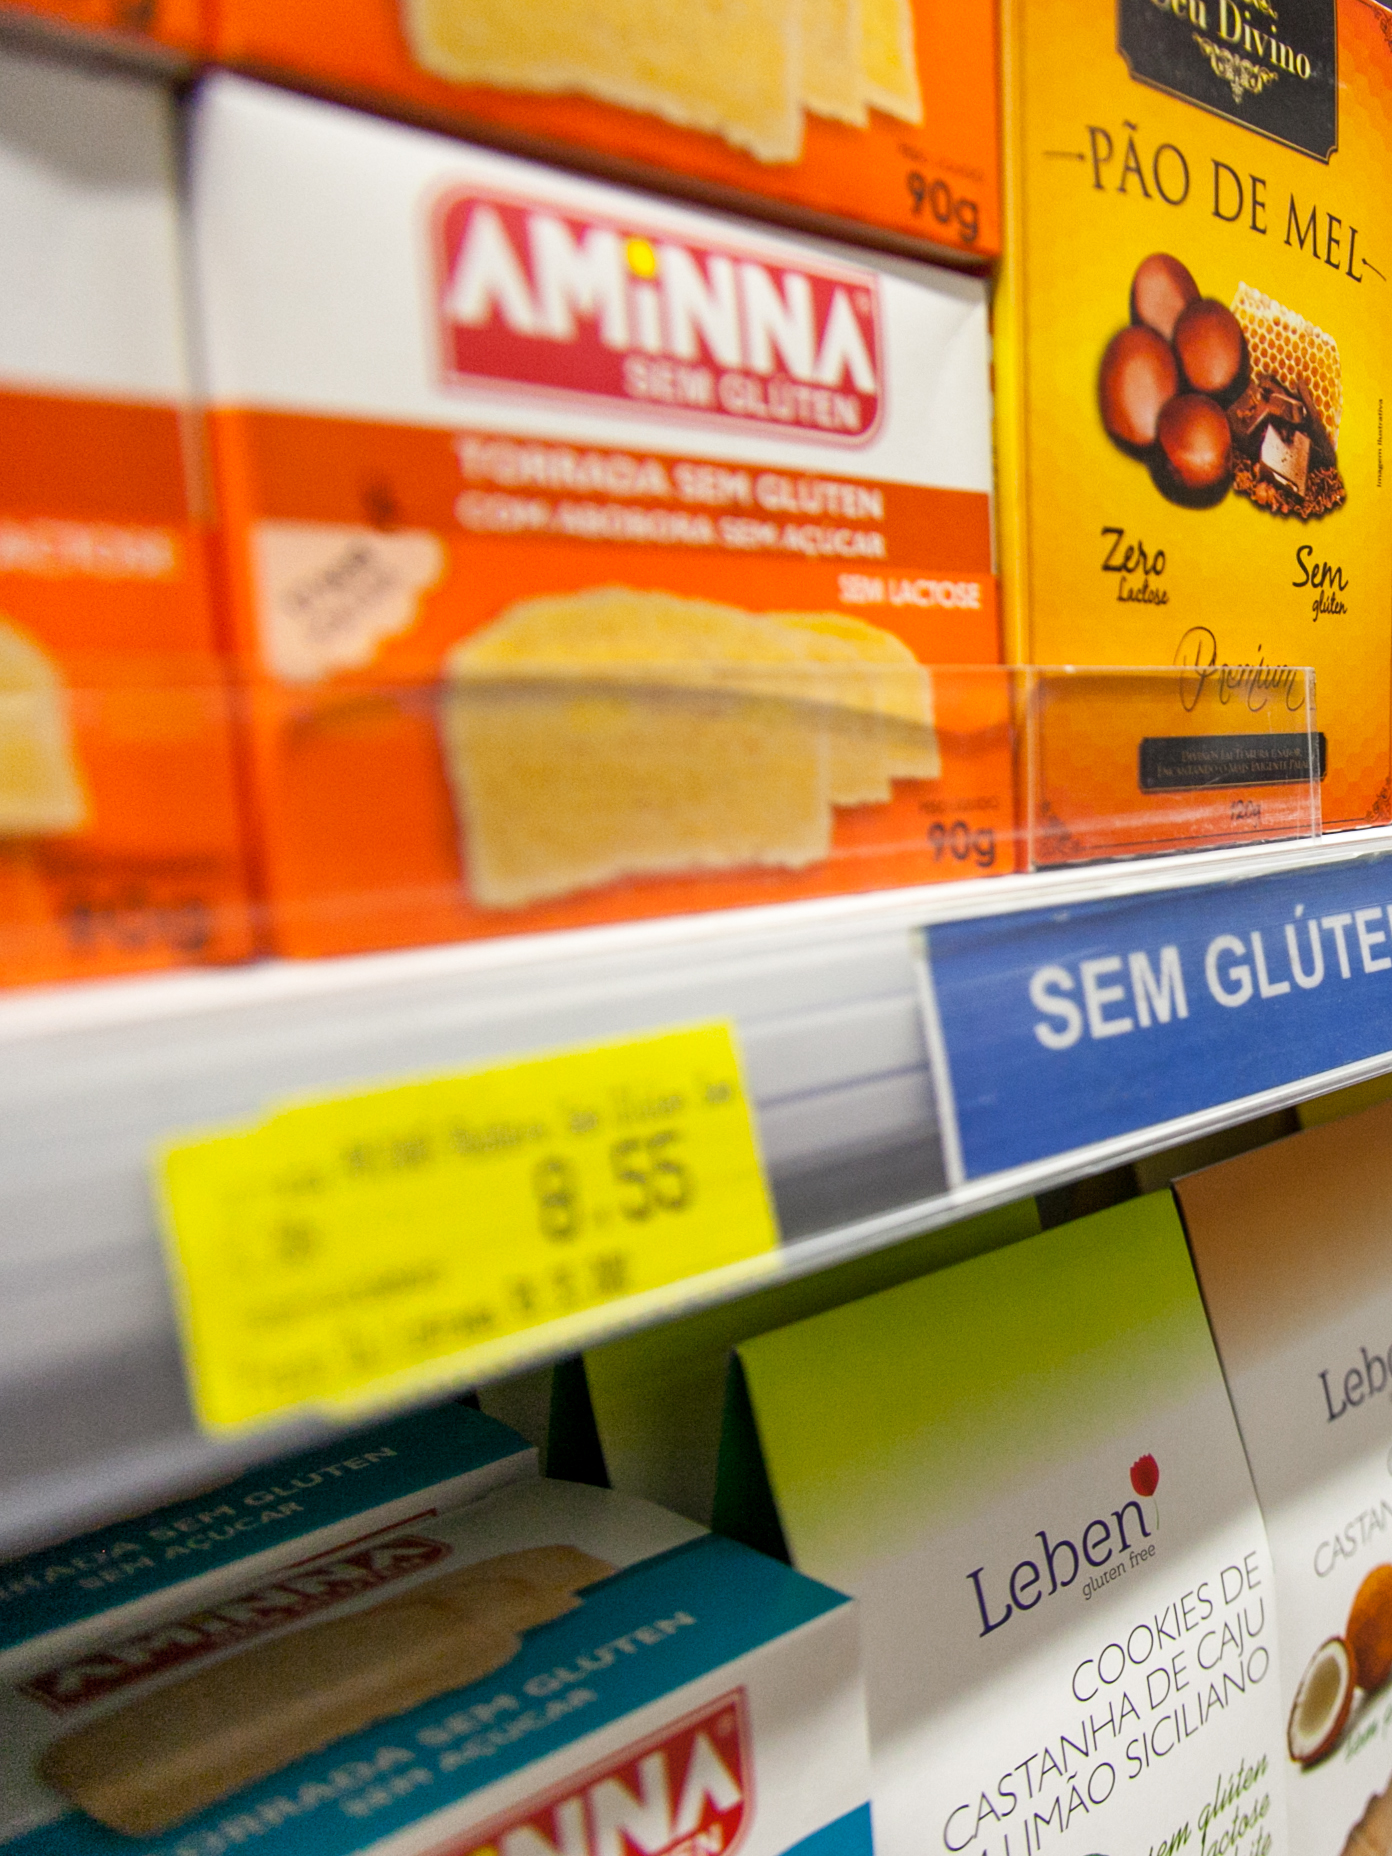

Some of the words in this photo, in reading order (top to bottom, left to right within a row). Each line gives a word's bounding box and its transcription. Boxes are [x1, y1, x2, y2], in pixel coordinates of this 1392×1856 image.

[1155, 0, 1208, 31] eu
[1218, 0, 1311, 80] Divino
[906, 170, 979, 243] 90g
[1086, 120, 1190, 206] PÃO
[1211, 159, 1268, 235] DE
[1284, 193, 1363, 283] MEL
[1101, 526, 1167, 577] Zero
[1292, 545, 1349, 592] Sem
[1116, 576, 1170, 606] Lactose
[1311, 590, 1349, 623] glúten
[1173, 626, 1306, 713] Premium
[927, 819, 996, 868] 90g
[1029, 945, 1189, 1051] SEM
[966, 1499, 1152, 1638] Leben
[1081, 1565, 1127, 1601] gluten
[1129, 1543, 1157, 1570] free
[1071, 1581, 1214, 1702] COOKIES
[1219, 1551, 1263, 1606] DE
[942, 1690, 1141, 1852] CASTANHA
[1146, 1650, 1190, 1711] DE
[1196, 1596, 1266, 1671] CAJU
[1125, 1645, 1270, 1781] SICILIANO
[1148, 1820, 1192, 1856] em
[1205, 1792, 1271, 1856] actose
